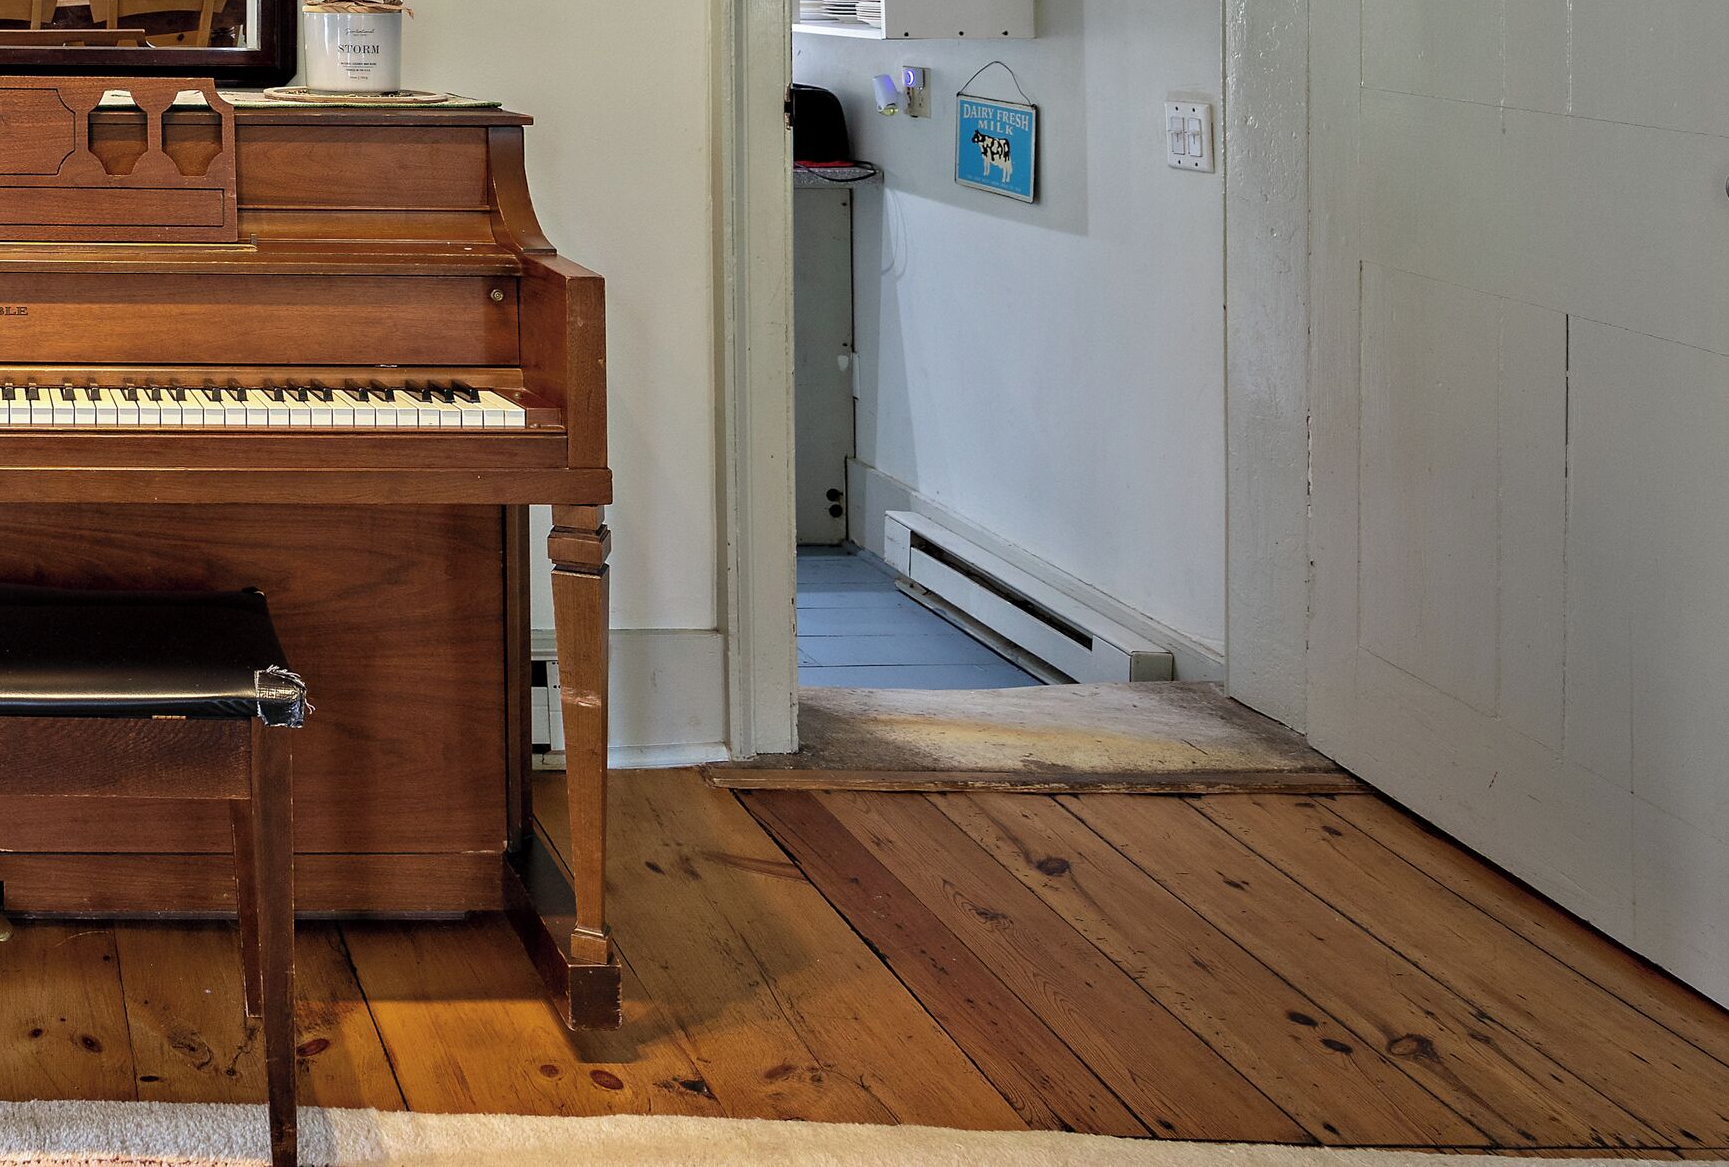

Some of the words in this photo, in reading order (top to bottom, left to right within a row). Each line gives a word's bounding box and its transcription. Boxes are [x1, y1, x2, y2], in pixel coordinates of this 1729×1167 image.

[338, 44, 380, 54] STORM
[963, 104, 994, 119] DAIRY
[997, 109, 1029, 131] FRESH
[978, 119, 1013, 136] MILK
